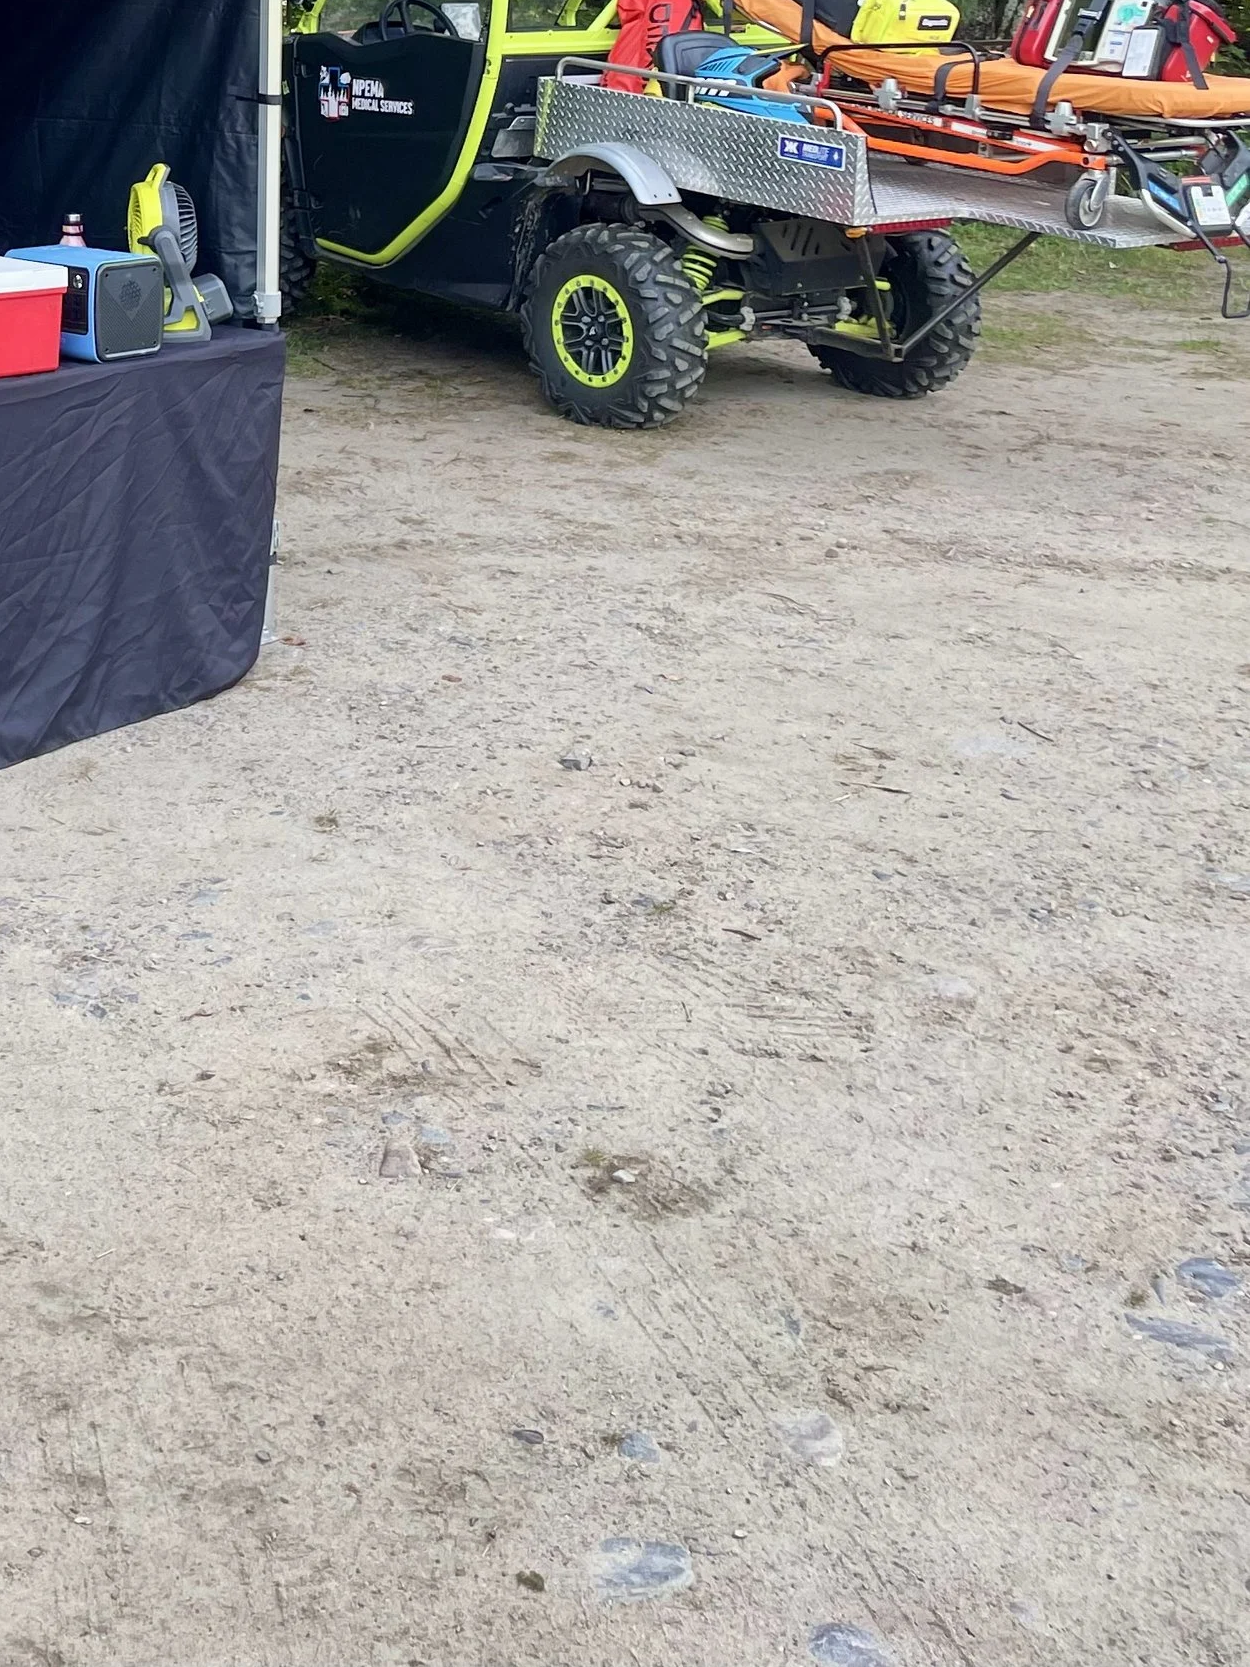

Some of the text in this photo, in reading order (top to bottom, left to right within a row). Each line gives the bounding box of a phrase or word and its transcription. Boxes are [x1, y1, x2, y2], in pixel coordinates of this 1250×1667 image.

[352, 79, 384, 98] NPEMA
[352, 97, 413, 115] MEDICAL SERVICES
